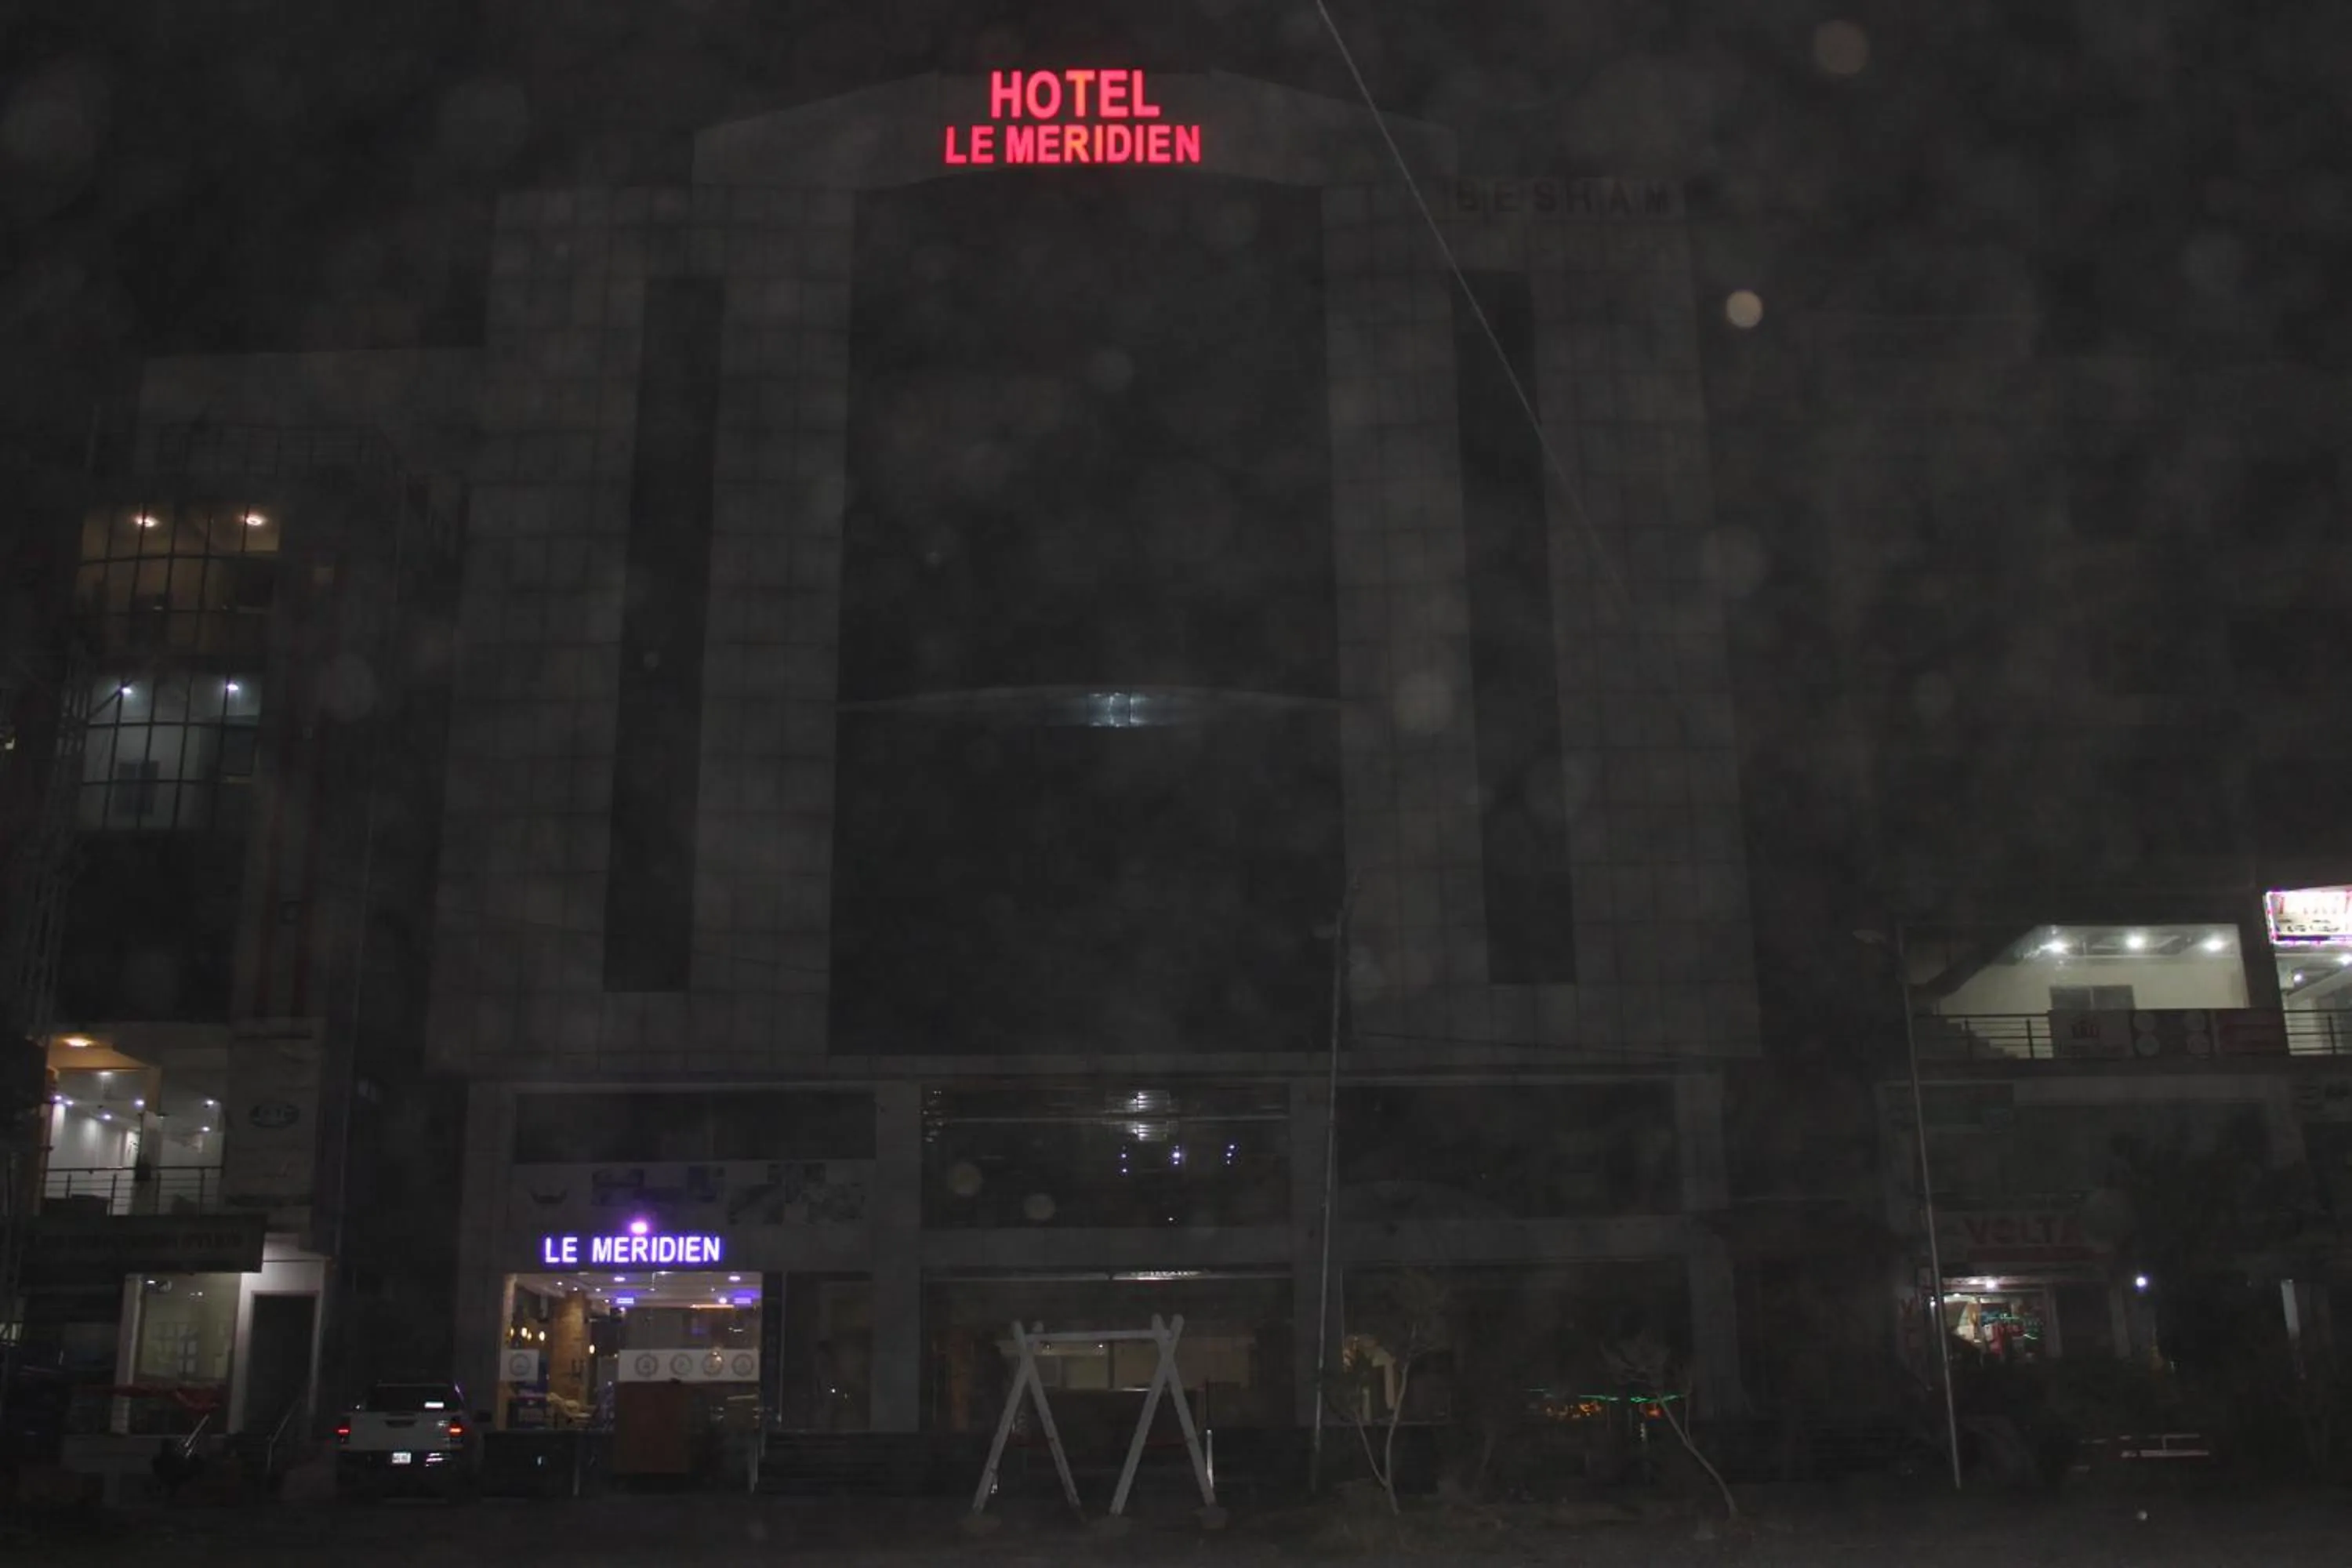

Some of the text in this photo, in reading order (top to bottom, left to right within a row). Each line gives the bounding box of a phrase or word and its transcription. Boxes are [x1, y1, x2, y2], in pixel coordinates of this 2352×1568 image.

[991, 70, 1160, 118] HOTEL
[946, 125, 1200, 163] LE MERIDIEN
[1457, 179, 1669, 213] BESHAM
[1962, 1214, 2085, 1245] VOLTA
[545, 1236, 720, 1263] LE MERIDIEN
